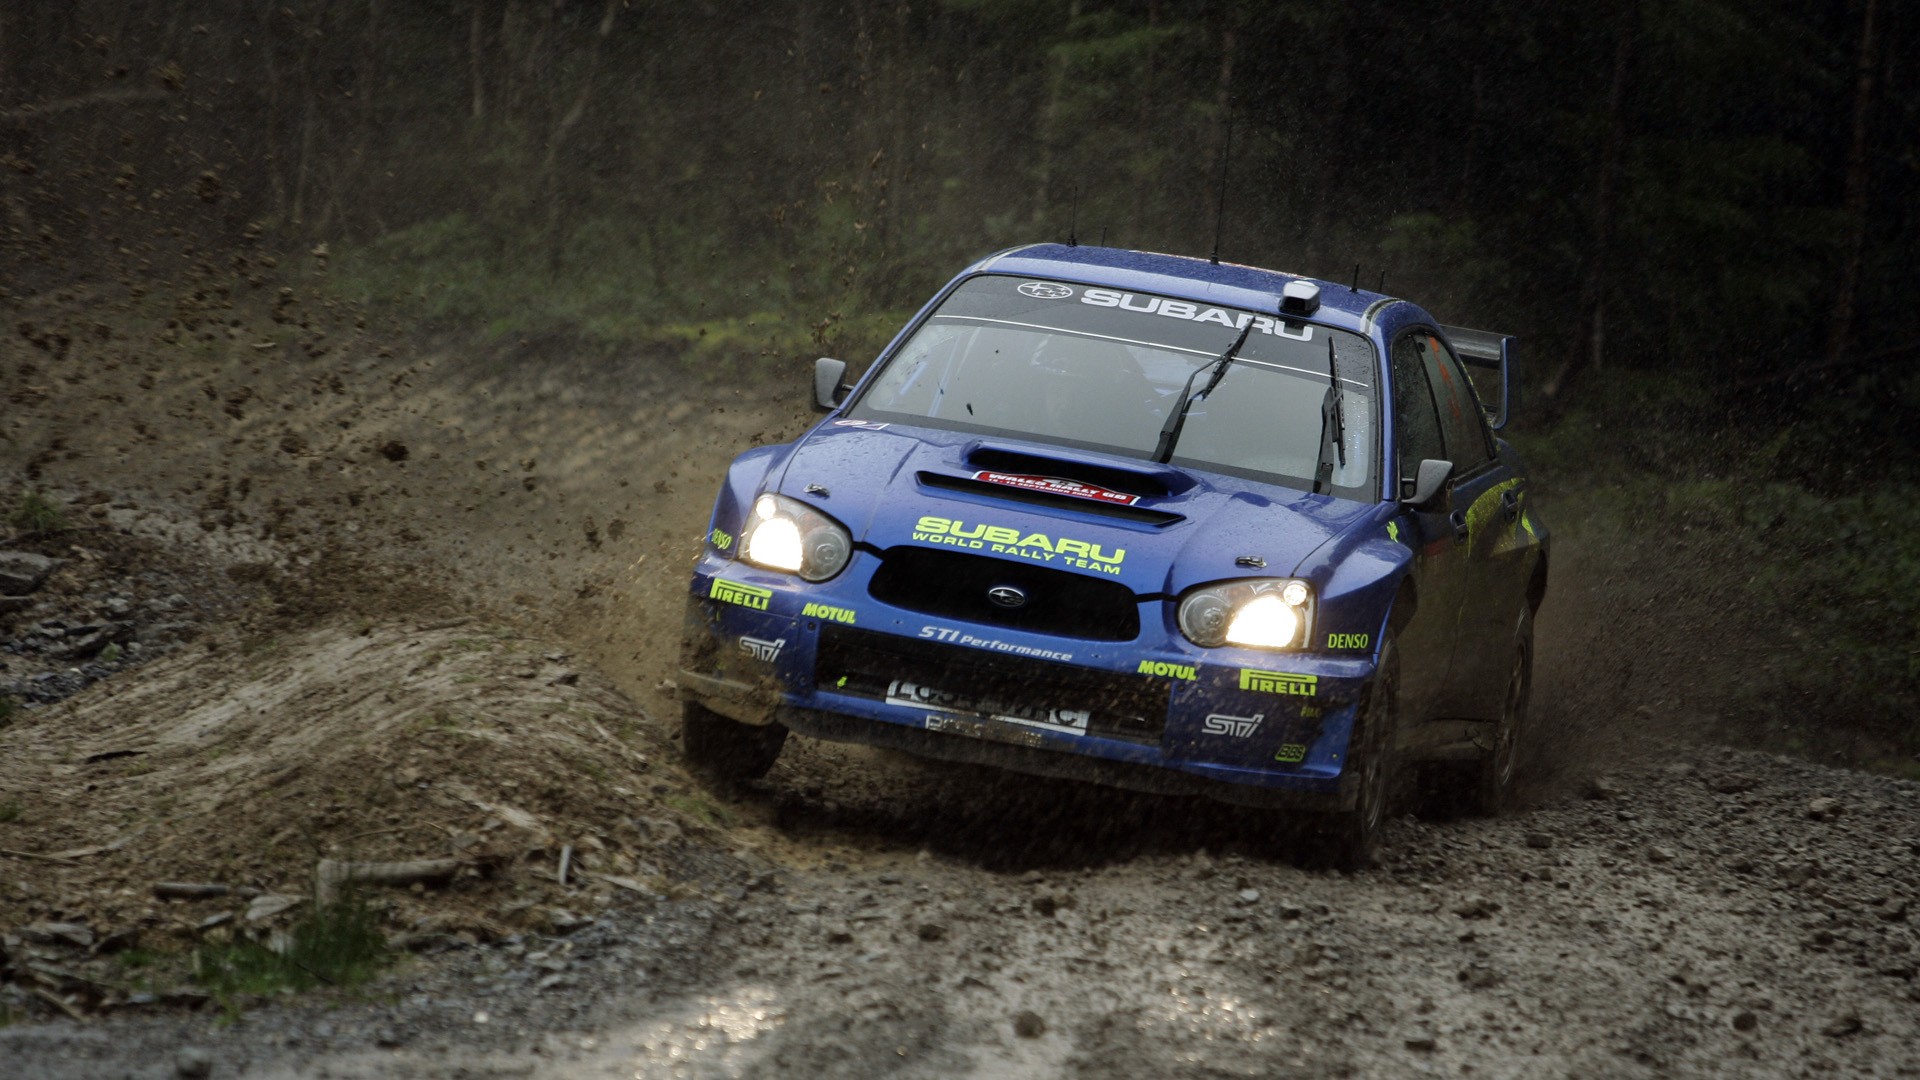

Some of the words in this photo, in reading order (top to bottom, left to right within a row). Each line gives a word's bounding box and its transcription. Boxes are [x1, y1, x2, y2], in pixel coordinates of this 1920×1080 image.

[1081, 289, 1314, 342] SUBARU
[989, 473, 1046, 486] WALES
[1050, 483, 1100, 495] RALLY
[912, 532, 984, 549] WORLD
[991, 544, 1056, 561] RALLY
[1064, 556, 1121, 575] TEAM
[915, 516, 1126, 564] SUBARU
[709, 578, 773, 611] PIRELLI
[801, 602, 857, 624] MOTUL
[918, 626, 960, 642] STI
[960, 635, 1073, 662] Performance
[1327, 633, 1369, 649] DENSO
[1137, 660, 1198, 681] MOTUL
[1239, 668, 1318, 696] PIRELLI
